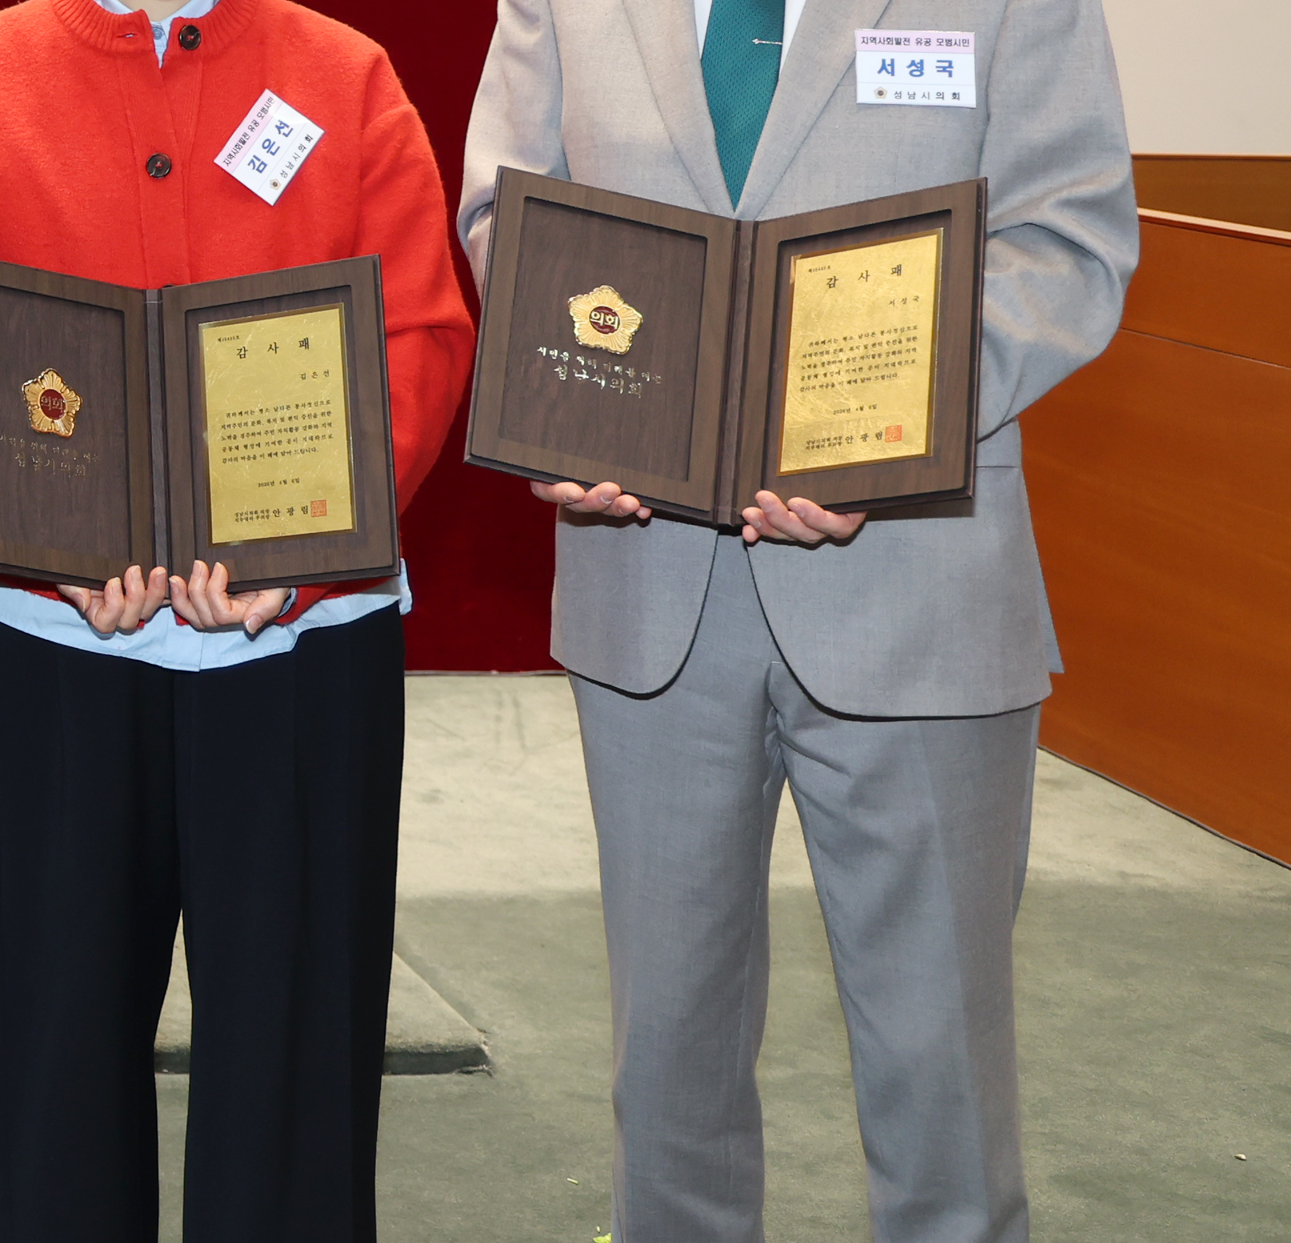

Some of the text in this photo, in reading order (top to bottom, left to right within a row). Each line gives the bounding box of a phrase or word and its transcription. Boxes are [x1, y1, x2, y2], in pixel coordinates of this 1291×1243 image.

[861, 37, 969, 47] 지역사회발전 유공 모범시민
[894, 91, 960, 100] 성남시의회
[223, 96, 274, 166] 지역사회발전 유공 모범시민
[280, 134, 313, 178] 성남시의회
[591, 312, 618, 329] 의회
